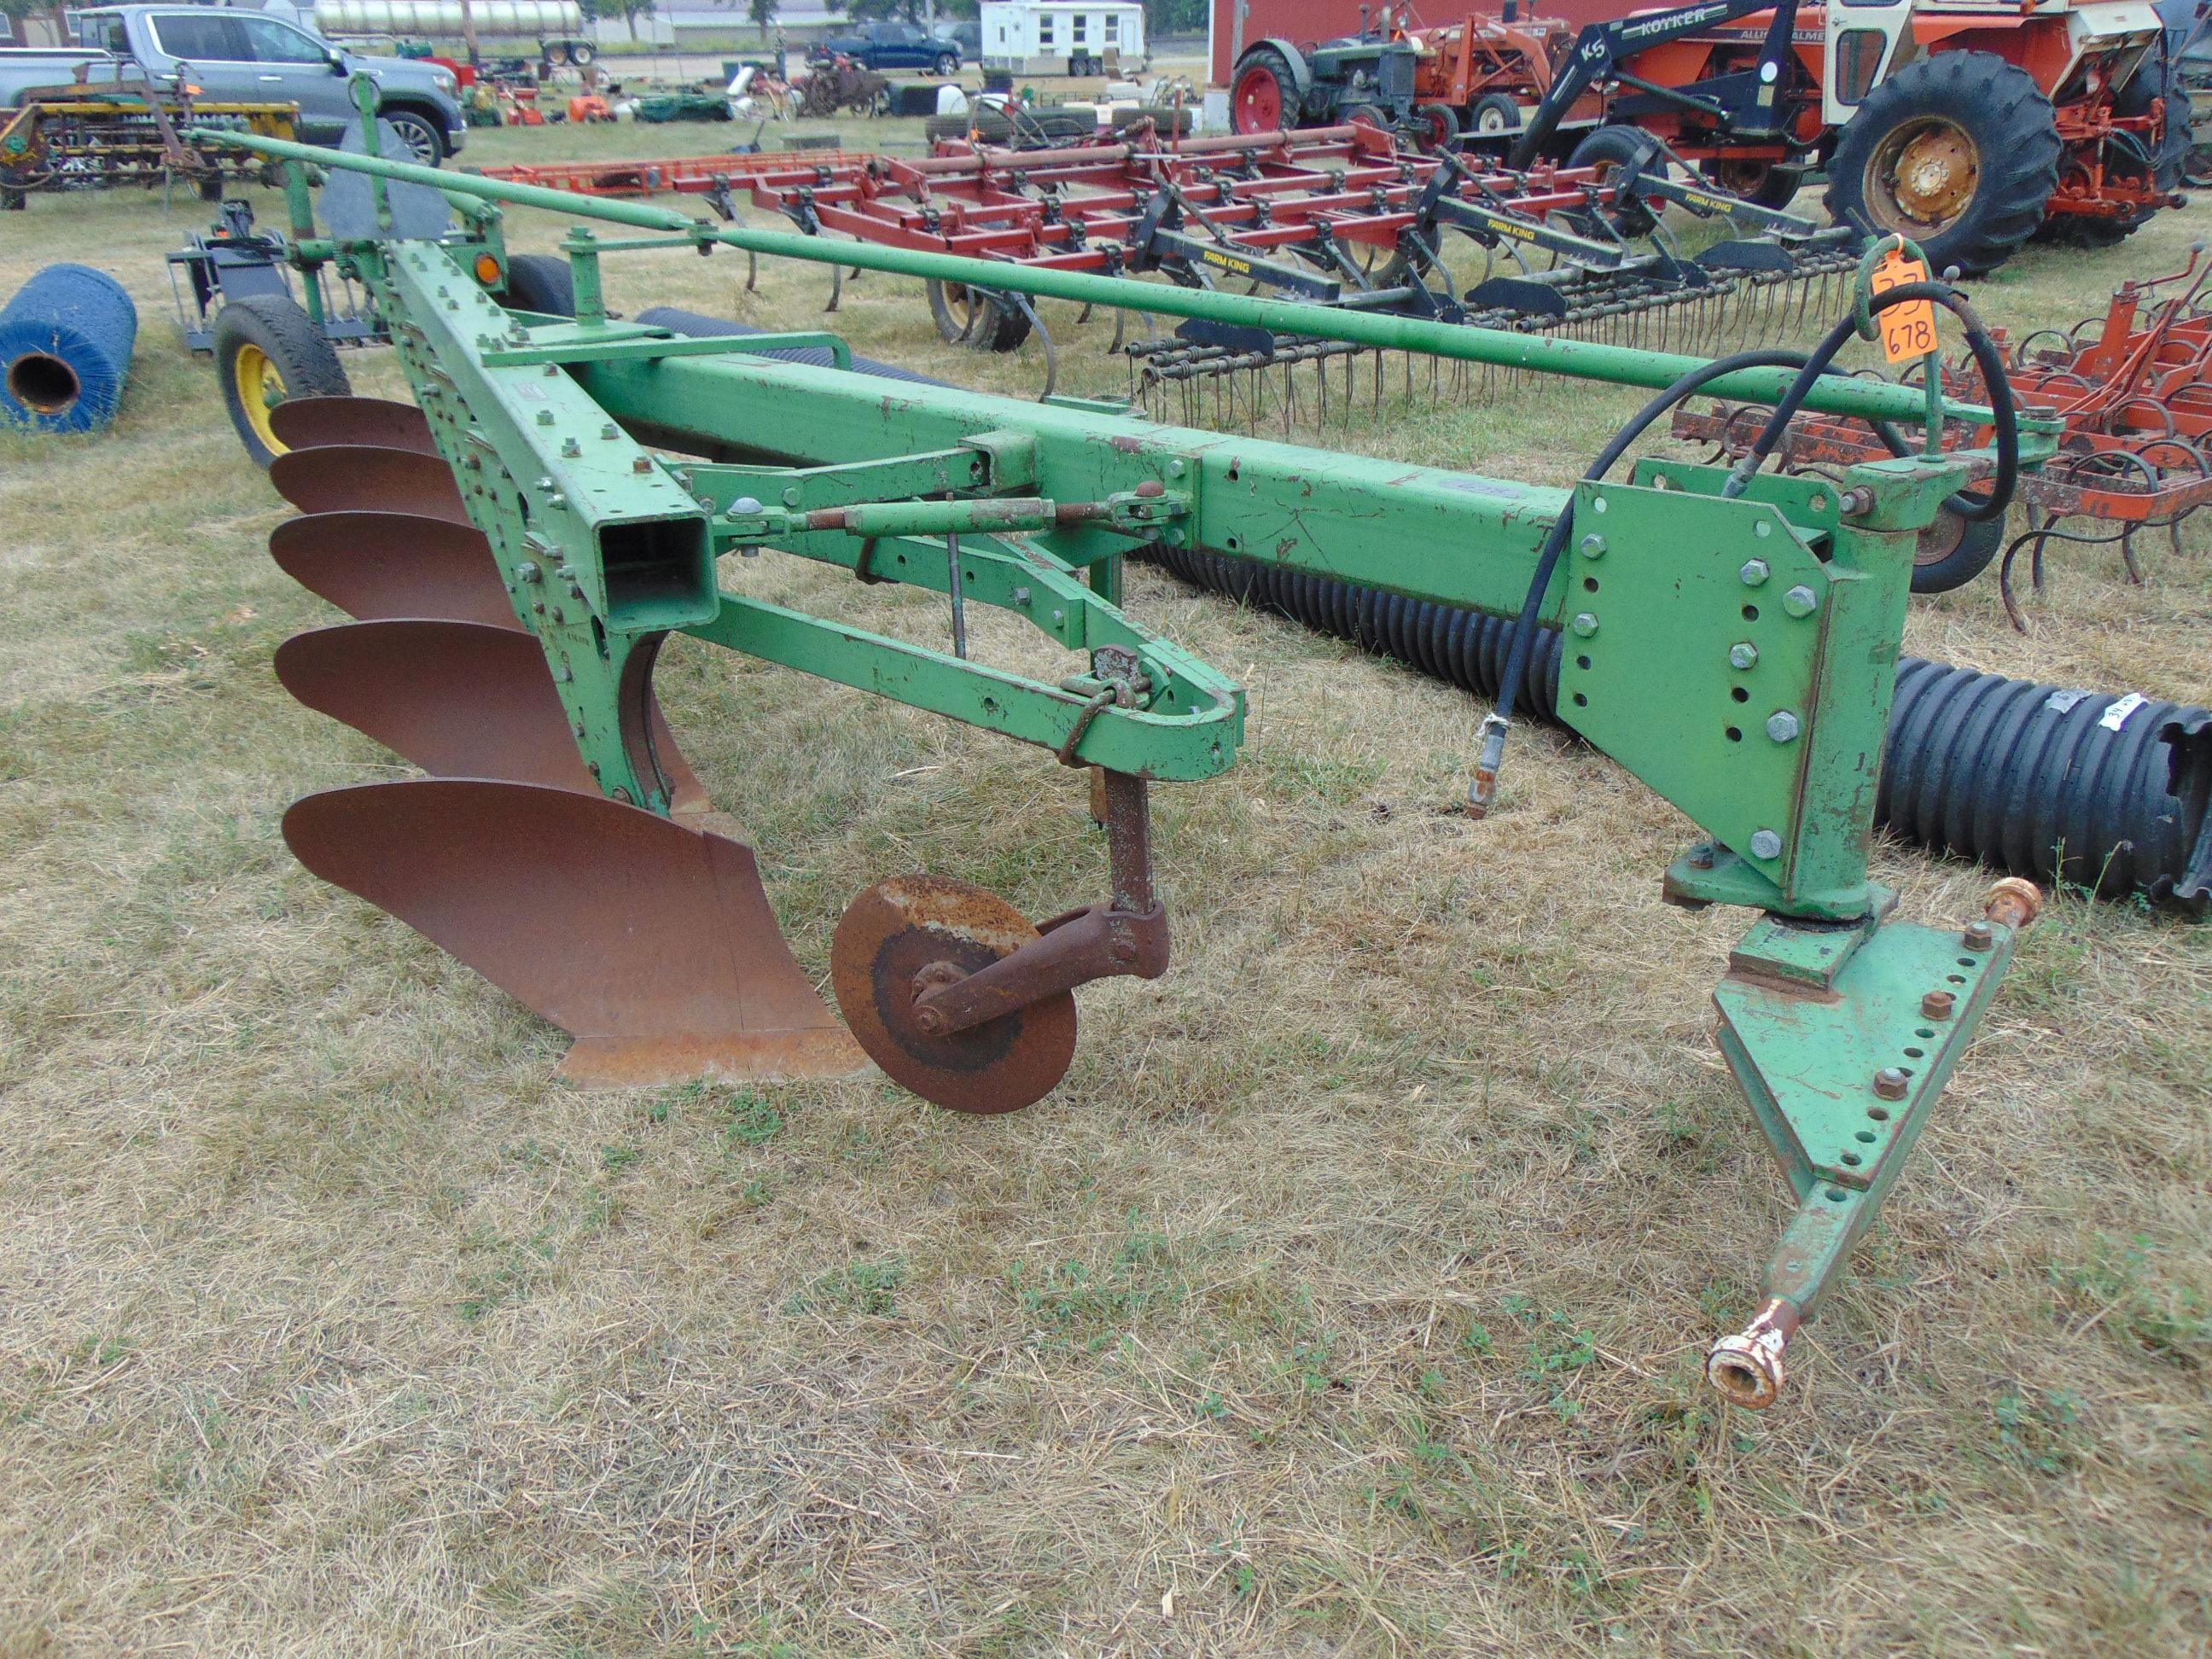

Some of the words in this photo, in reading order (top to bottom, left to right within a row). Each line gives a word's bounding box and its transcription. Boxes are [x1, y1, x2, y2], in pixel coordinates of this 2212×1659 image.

[1641, 9, 1706, 36] KOYKER
[1580, 38, 1605, 62] K5
[1685, 193, 1708, 207] FARM
[1709, 199, 1732, 213] KING
[1487, 218, 1511, 233] FARM
[1512, 225, 1535, 241] KING
[1203, 250, 1226, 266] FARM
[1227, 258, 1249, 274] KING
[1888, 320, 1930, 355] 678
